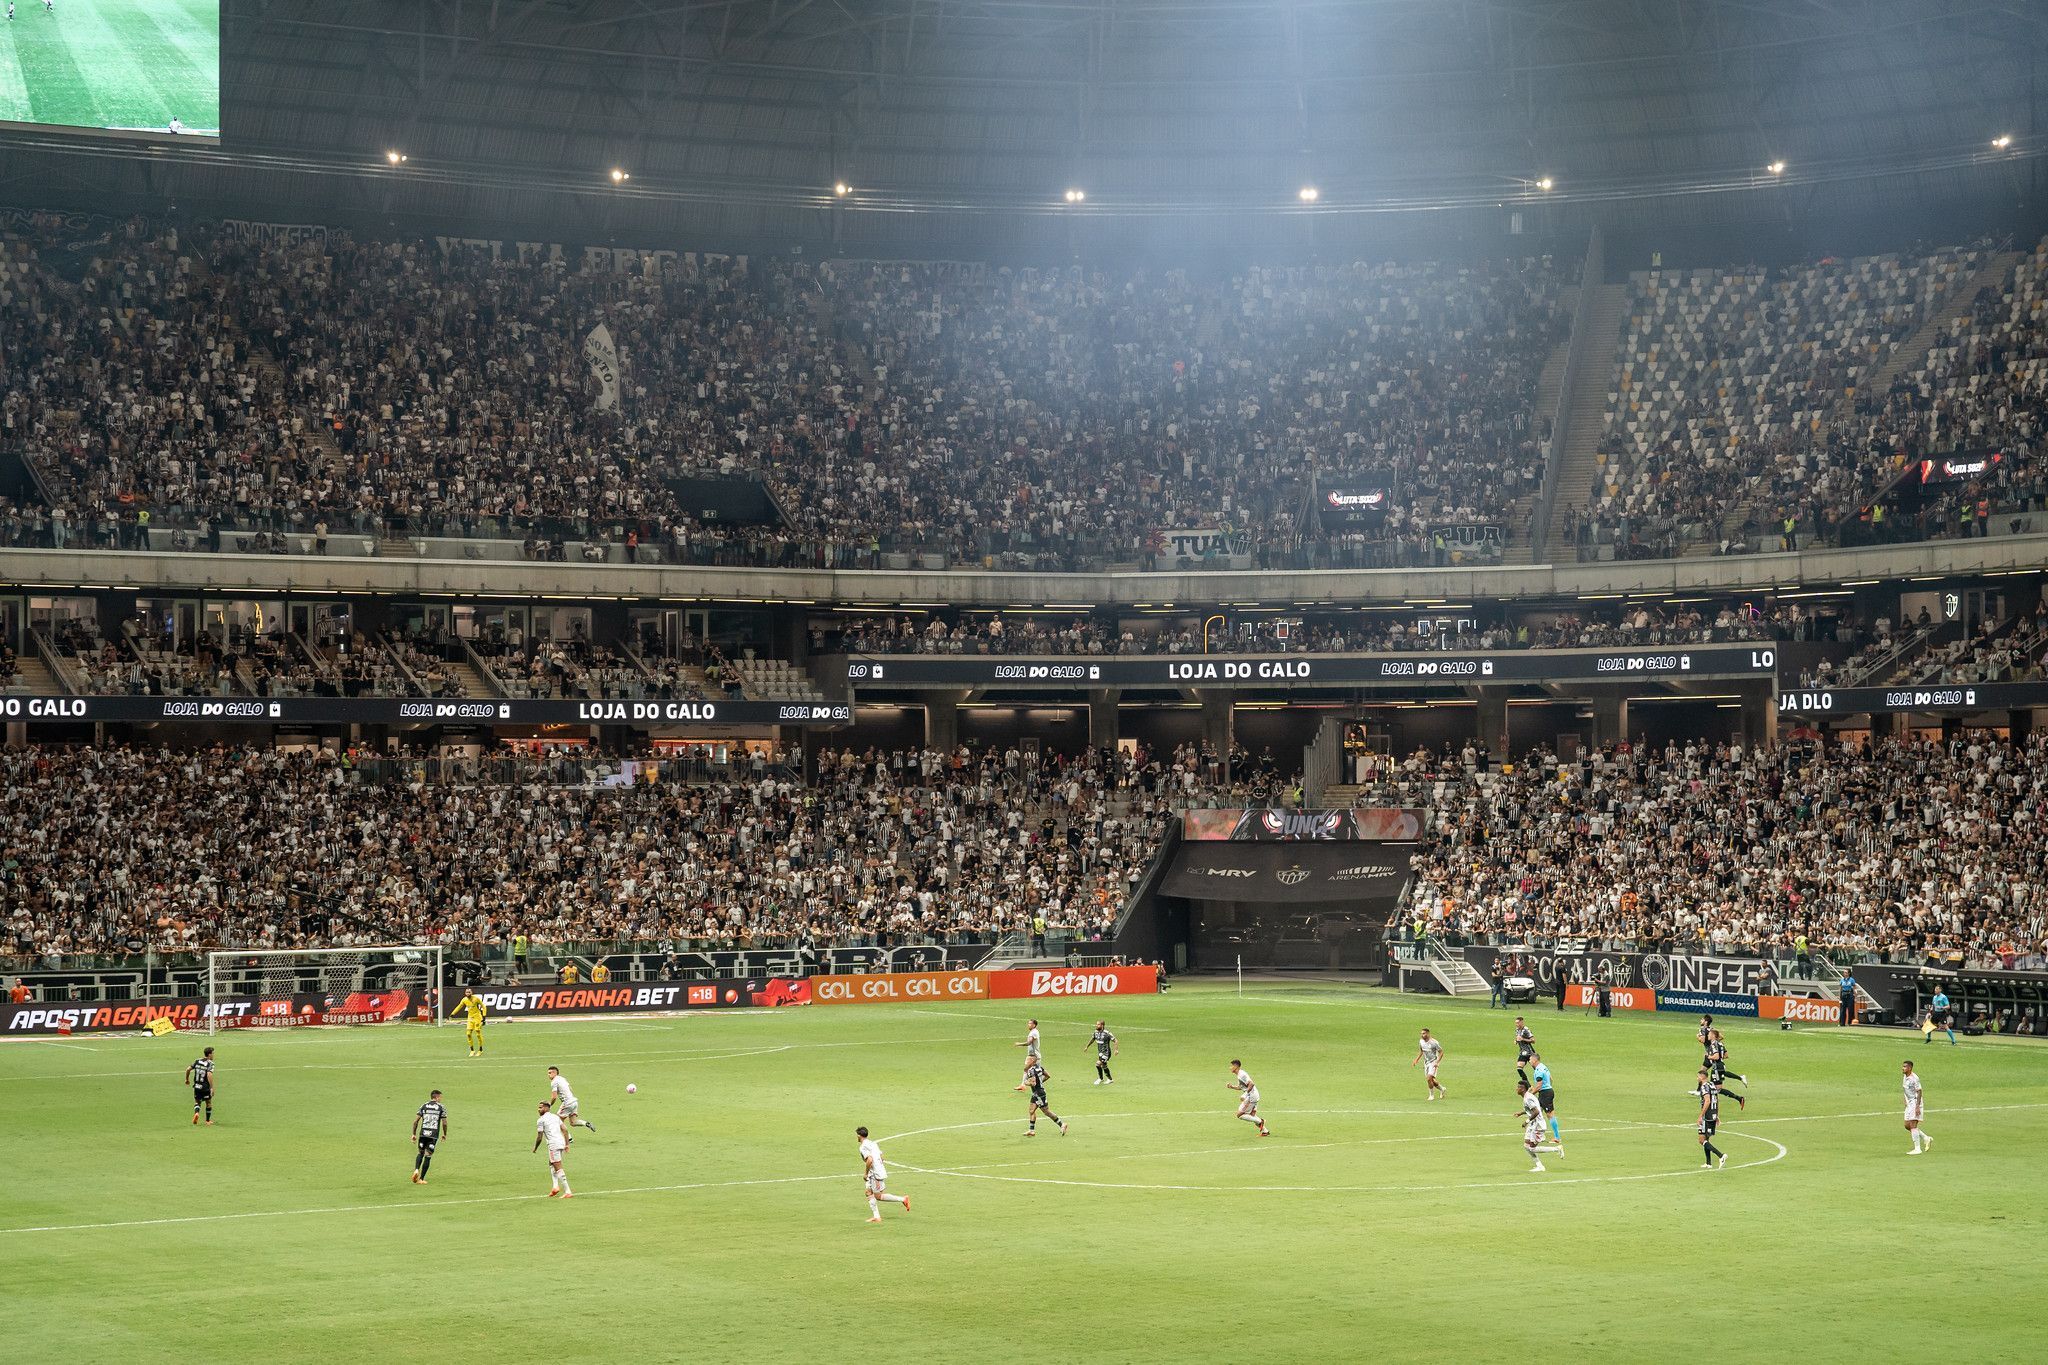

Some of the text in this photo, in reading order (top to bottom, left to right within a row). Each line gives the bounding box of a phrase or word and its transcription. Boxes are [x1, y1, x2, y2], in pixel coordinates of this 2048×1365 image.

[1598, 656, 1676, 670] LOJA DO GALO
[1752, 651, 1774, 667] LO
[848, 665, 867, 677] LO
[995, 665, 1084, 677] LOJA DO GALO
[1169, 662, 1311, 679] LOJA DO GALO
[1381, 662, 1476, 675] LOJA DO GALO
[1779, 693, 1832, 710] JA DLO
[1886, 691, 1962, 705] LOJA DO GALO
[0, 699, 87, 716] O GALO
[163, 702, 263, 716] LOJA DO GALO
[400, 704, 494, 717] LOJA DO GALO
[579, 703, 715, 720] LOJA DO GALO
[779, 706, 809, 719] LOJA
[811, 707, 830, 719] DO
[1278, 815, 1336, 833] UNC
[1207, 868, 1257, 877] MRV
[818, 981, 855, 999] GOL
[862, 979, 898, 997] GOL
[905, 978, 941, 996] GOL
[947, 976, 983, 994] GOL
[1031, 971, 1118, 995] Betano
[691, 988, 713, 1001] +18
[1581, 987, 1633, 1008] Beano
[264, 1003, 287, 1015] +18
[1664, 996, 1755, 1010] BRASILEIRÃO Betano 2024
[9, 1003, 251, 1030] APOSTAGANHABET
[321, 1011, 381, 1024] SUPERBET
[1784, 1000, 1840, 1022] Betano
[250, 1014, 312, 1026] SUPERBET
